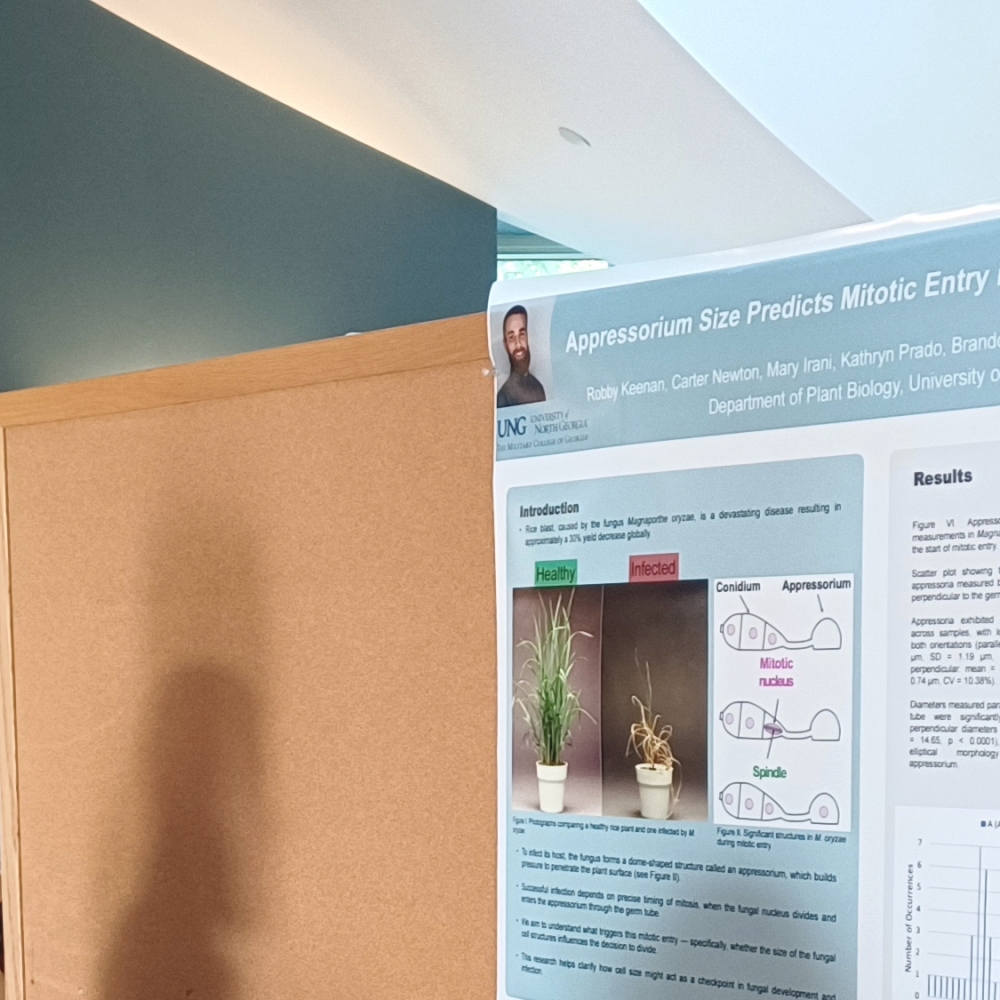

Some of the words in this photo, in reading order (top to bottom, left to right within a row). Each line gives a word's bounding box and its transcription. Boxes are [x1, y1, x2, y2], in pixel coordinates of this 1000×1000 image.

[565, 315, 693, 356] Appressorium
[699, 307, 741, 331] Size
[747, 292, 834, 324] Predicts
[841, 277, 917, 310] Mitotic
[925, 268, 990, 296] Entry
[587, 385, 619, 401] Robby
[621, 379, 668, 397] Keenan,
[672, 372, 709, 390] Carter
[712, 366, 763, 385] Newton,
[767, 360, 799, 378] Mary
[803, 352, 836, 373] Irani,
[841, 348, 894, 369] Kathryn
[899, 340, 946, 361] Prado,
[709, 392, 785, 416] Department
[789, 388, 804, 405] of
[806, 384, 843, 403] Plant
[847, 379, 904, 398] Biology,
[909, 367, 985, 391] University
[498, 416, 526, 438] UNG
[914, 469, 973, 486] Results
[520, 502, 579, 518] Introduction
[525, 525, 537, 533] Rice
[580, 521, 588, 530] by
[591, 520, 600, 528] the
[603, 518, 624, 529] fungus
[627, 515, 668, 526] Magnaporthe
[700, 511, 706, 520] is
[710, 512, 715, 520] a
[719, 508, 761, 519] devastating
[765, 506, 793, 516] disease
[798, 503, 830, 515] resulting
[834, 502, 841, 511] in
[913, 521, 935, 531] Figure
[583, 533, 596, 543] yield
[598, 531, 626, 542] decrease
[912, 532, 965, 541] measurements
[925, 545, 941, 553] start
[943, 544, 951, 552] of
[952, 543, 976, 551] mitotic
[536, 566, 576, 583] Healthy
[631, 560, 676, 577] Infected
[716, 581, 760, 592] Conidium
[782, 578, 851, 593] Appressorium
[760, 657, 794, 669] Mitotic
[759, 675, 794, 687] nucleus
[753, 766, 787, 780] Spindle
[905, 863, 914, 917] Occurrences
[905, 919, 913, 934] of
[905, 938, 913, 973] Number
